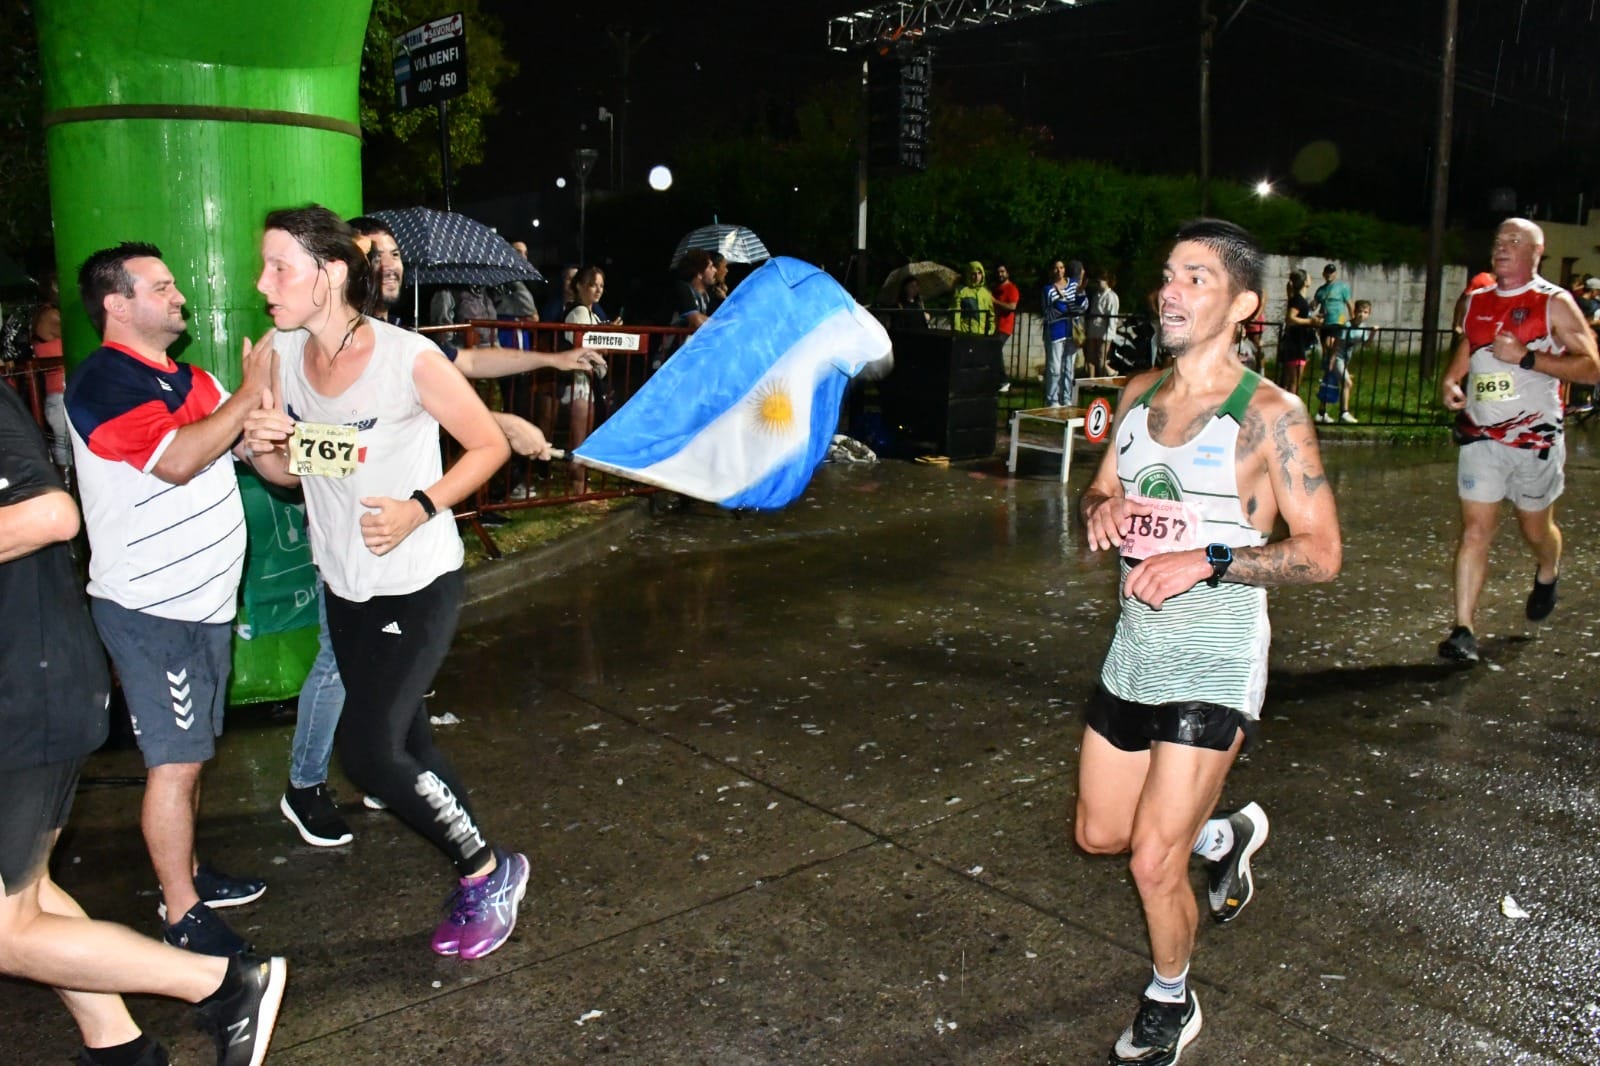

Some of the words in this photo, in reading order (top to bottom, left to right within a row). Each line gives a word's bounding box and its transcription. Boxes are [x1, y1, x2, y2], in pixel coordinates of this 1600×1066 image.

[414, 56, 427, 71] VIA
[429, 46, 459, 67] MENFI
[418, 79, 432, 93] 400
[439, 72, 457, 88] 450
[588, 335, 623, 346] PROYECTO
[1476, 380, 1510, 393] 669
[1094, 410, 1102, 431] 2
[299, 438, 355, 461] 767
[1126, 514, 1188, 542] 1857
